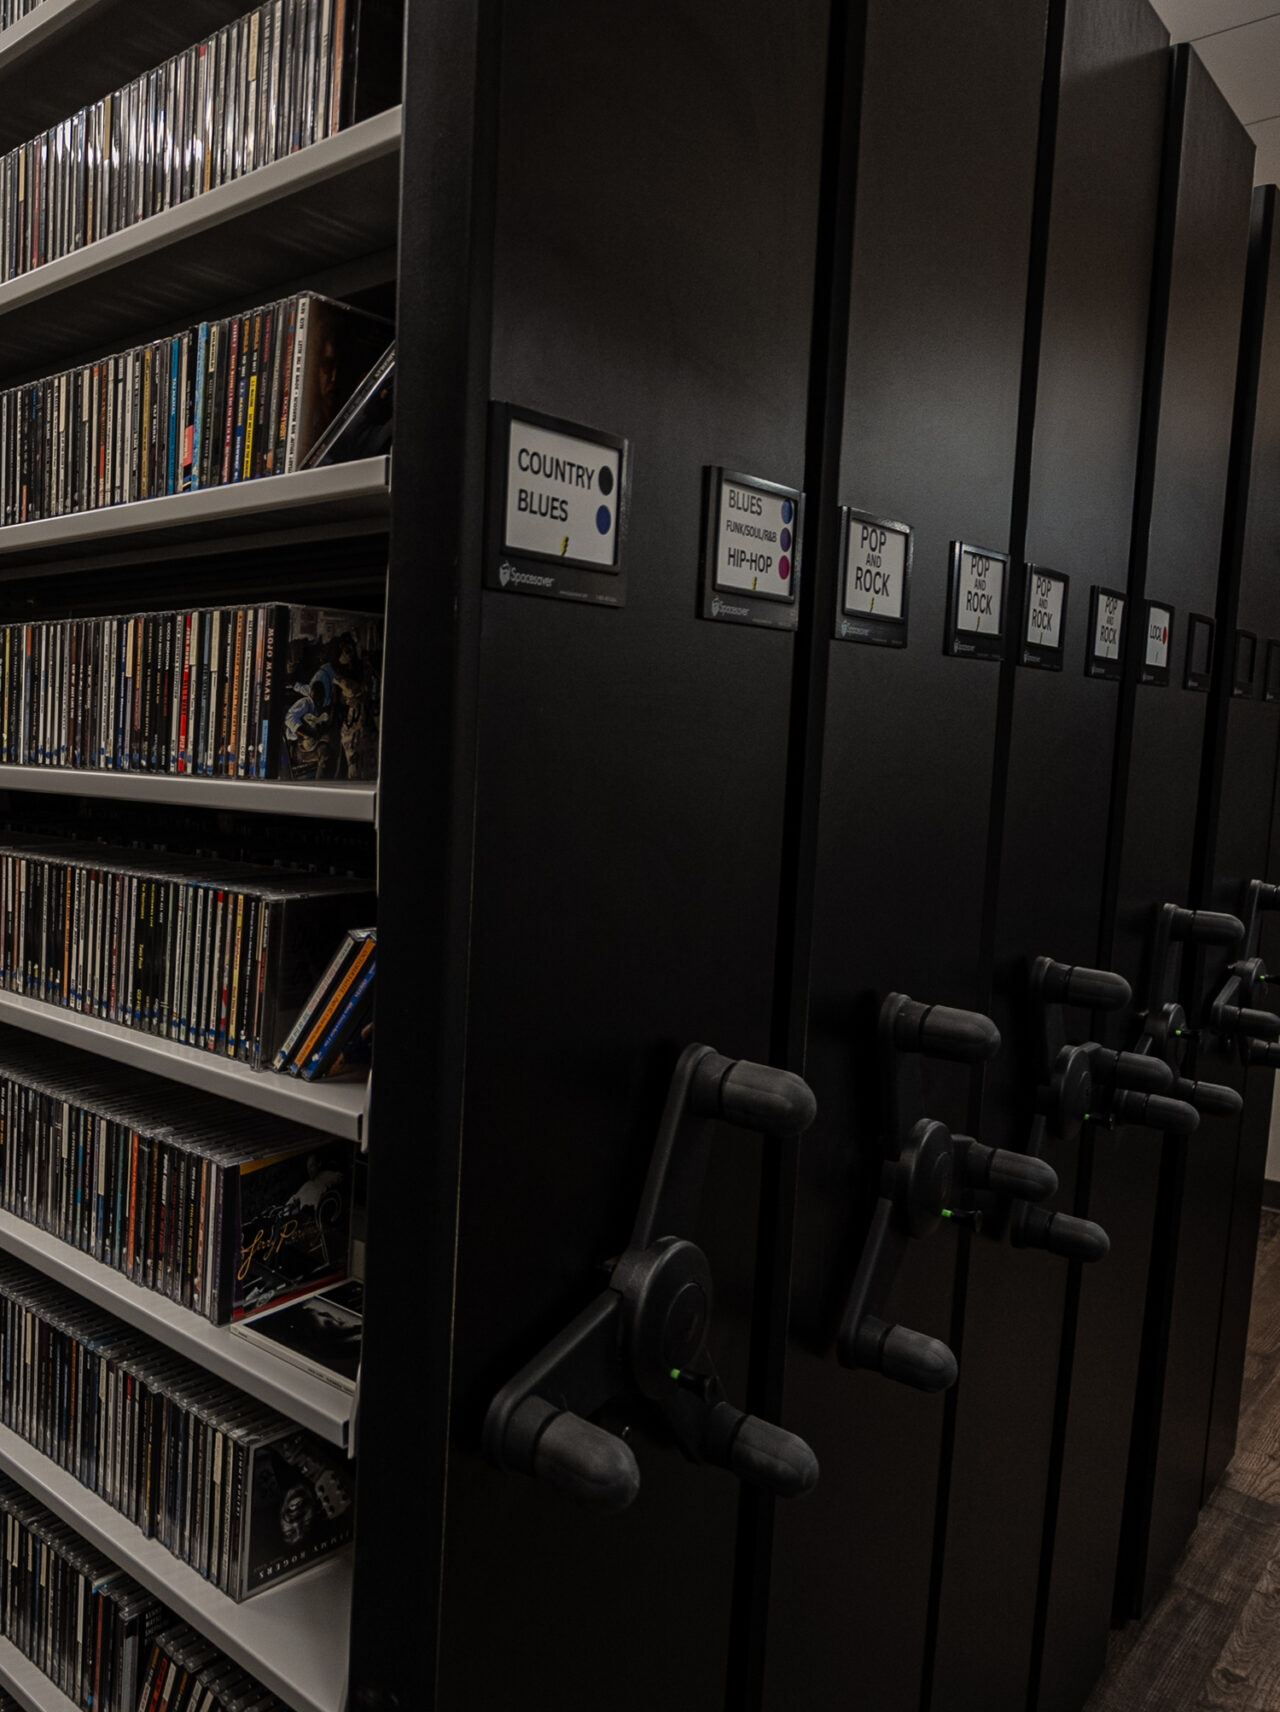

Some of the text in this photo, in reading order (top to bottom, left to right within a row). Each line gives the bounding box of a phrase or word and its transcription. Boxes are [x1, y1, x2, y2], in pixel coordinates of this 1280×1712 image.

[517, 448, 595, 490] COUNTRY
[517, 489, 568, 522] BLUES
[728, 489, 762, 516] BLUES
[860, 525, 886, 554] POP
[727, 547, 772, 574] HIP-HOP
[865, 553, 881, 568] AND
[970, 556, 990, 578] POP
[855, 566, 890, 597] ROCK
[974, 578, 986, 591] AND
[1035, 576, 1052, 599] POP
[966, 590, 993, 616] ROCK
[1104, 596, 1118, 615] POP
[1031, 609, 1053, 633] ROCK
[1149, 623, 1162, 642] LOCAL
[1100, 624, 1117, 645] ROCK
[263, 661, 272, 701] MAMAS
[258, 1551, 306, 1579] ROGERS
